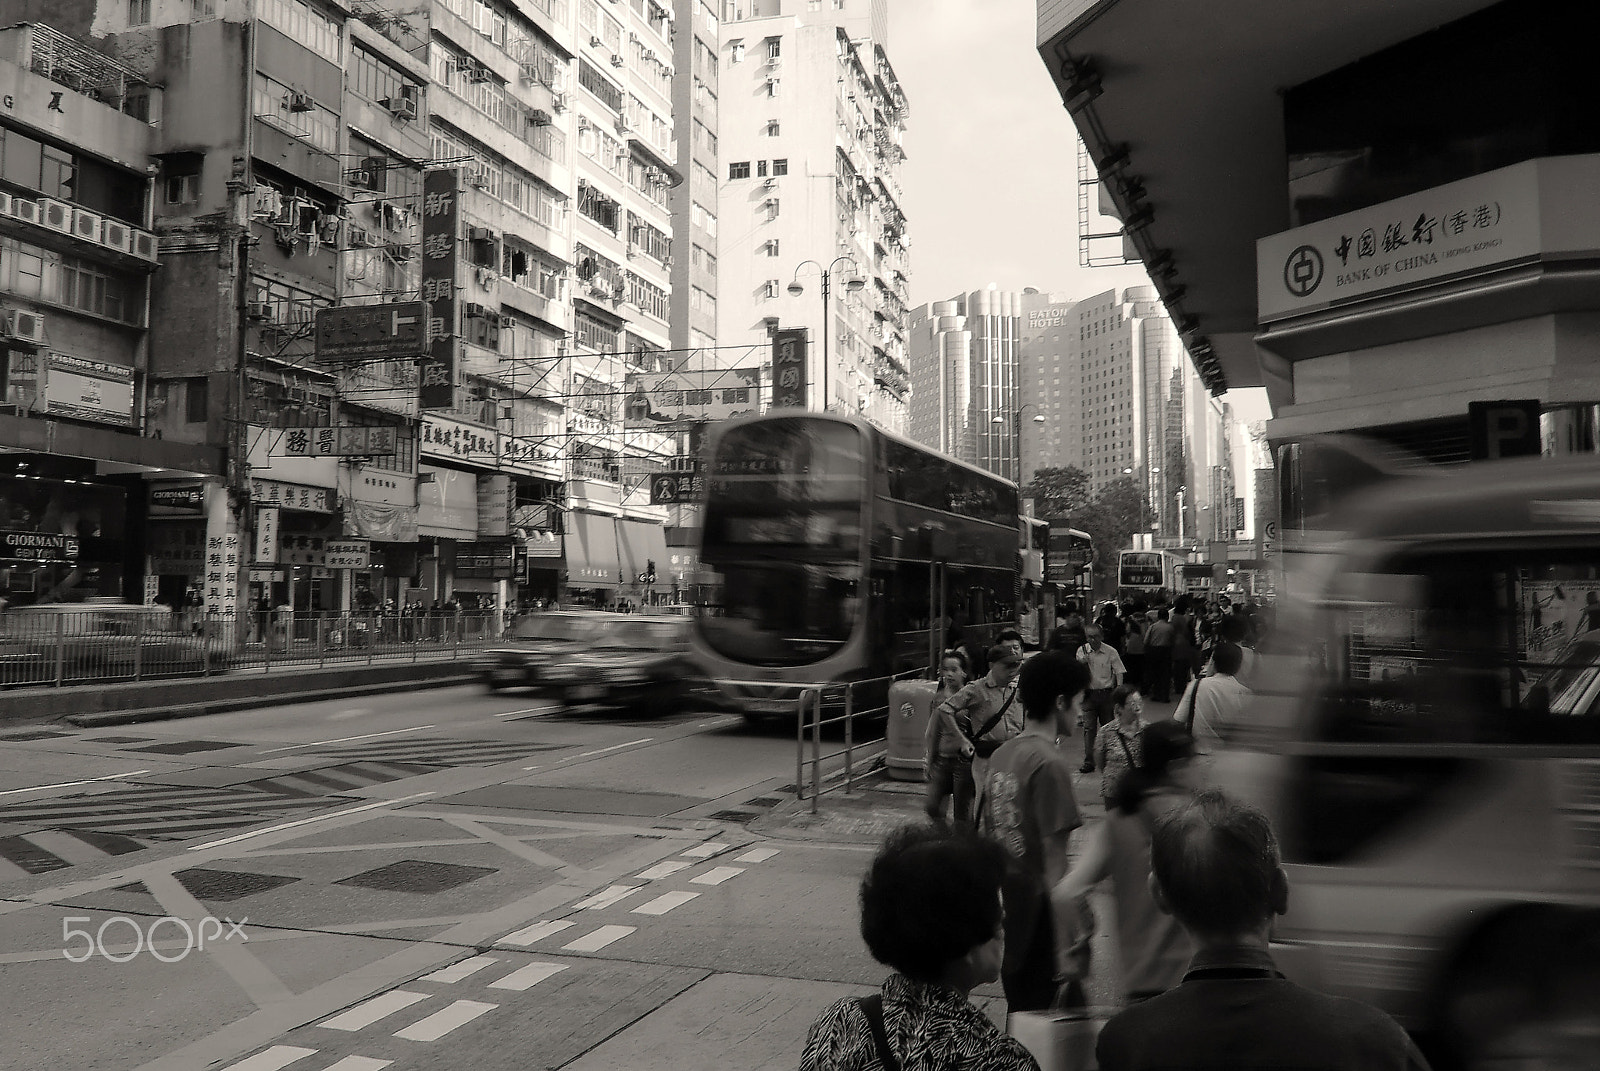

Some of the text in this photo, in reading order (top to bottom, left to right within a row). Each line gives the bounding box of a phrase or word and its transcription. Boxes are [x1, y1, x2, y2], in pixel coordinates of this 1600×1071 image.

[1336, 267, 1371, 287] BANK
[1374, 263, 1390, 277] OF
[1394, 252, 1438, 273] CHINA
[1028, 308, 1067, 319] EATON
[1028, 318, 1067, 328] HOTEL
[1487, 408, 1529, 459] P
[6, 534, 64, 548] GIORMANI
